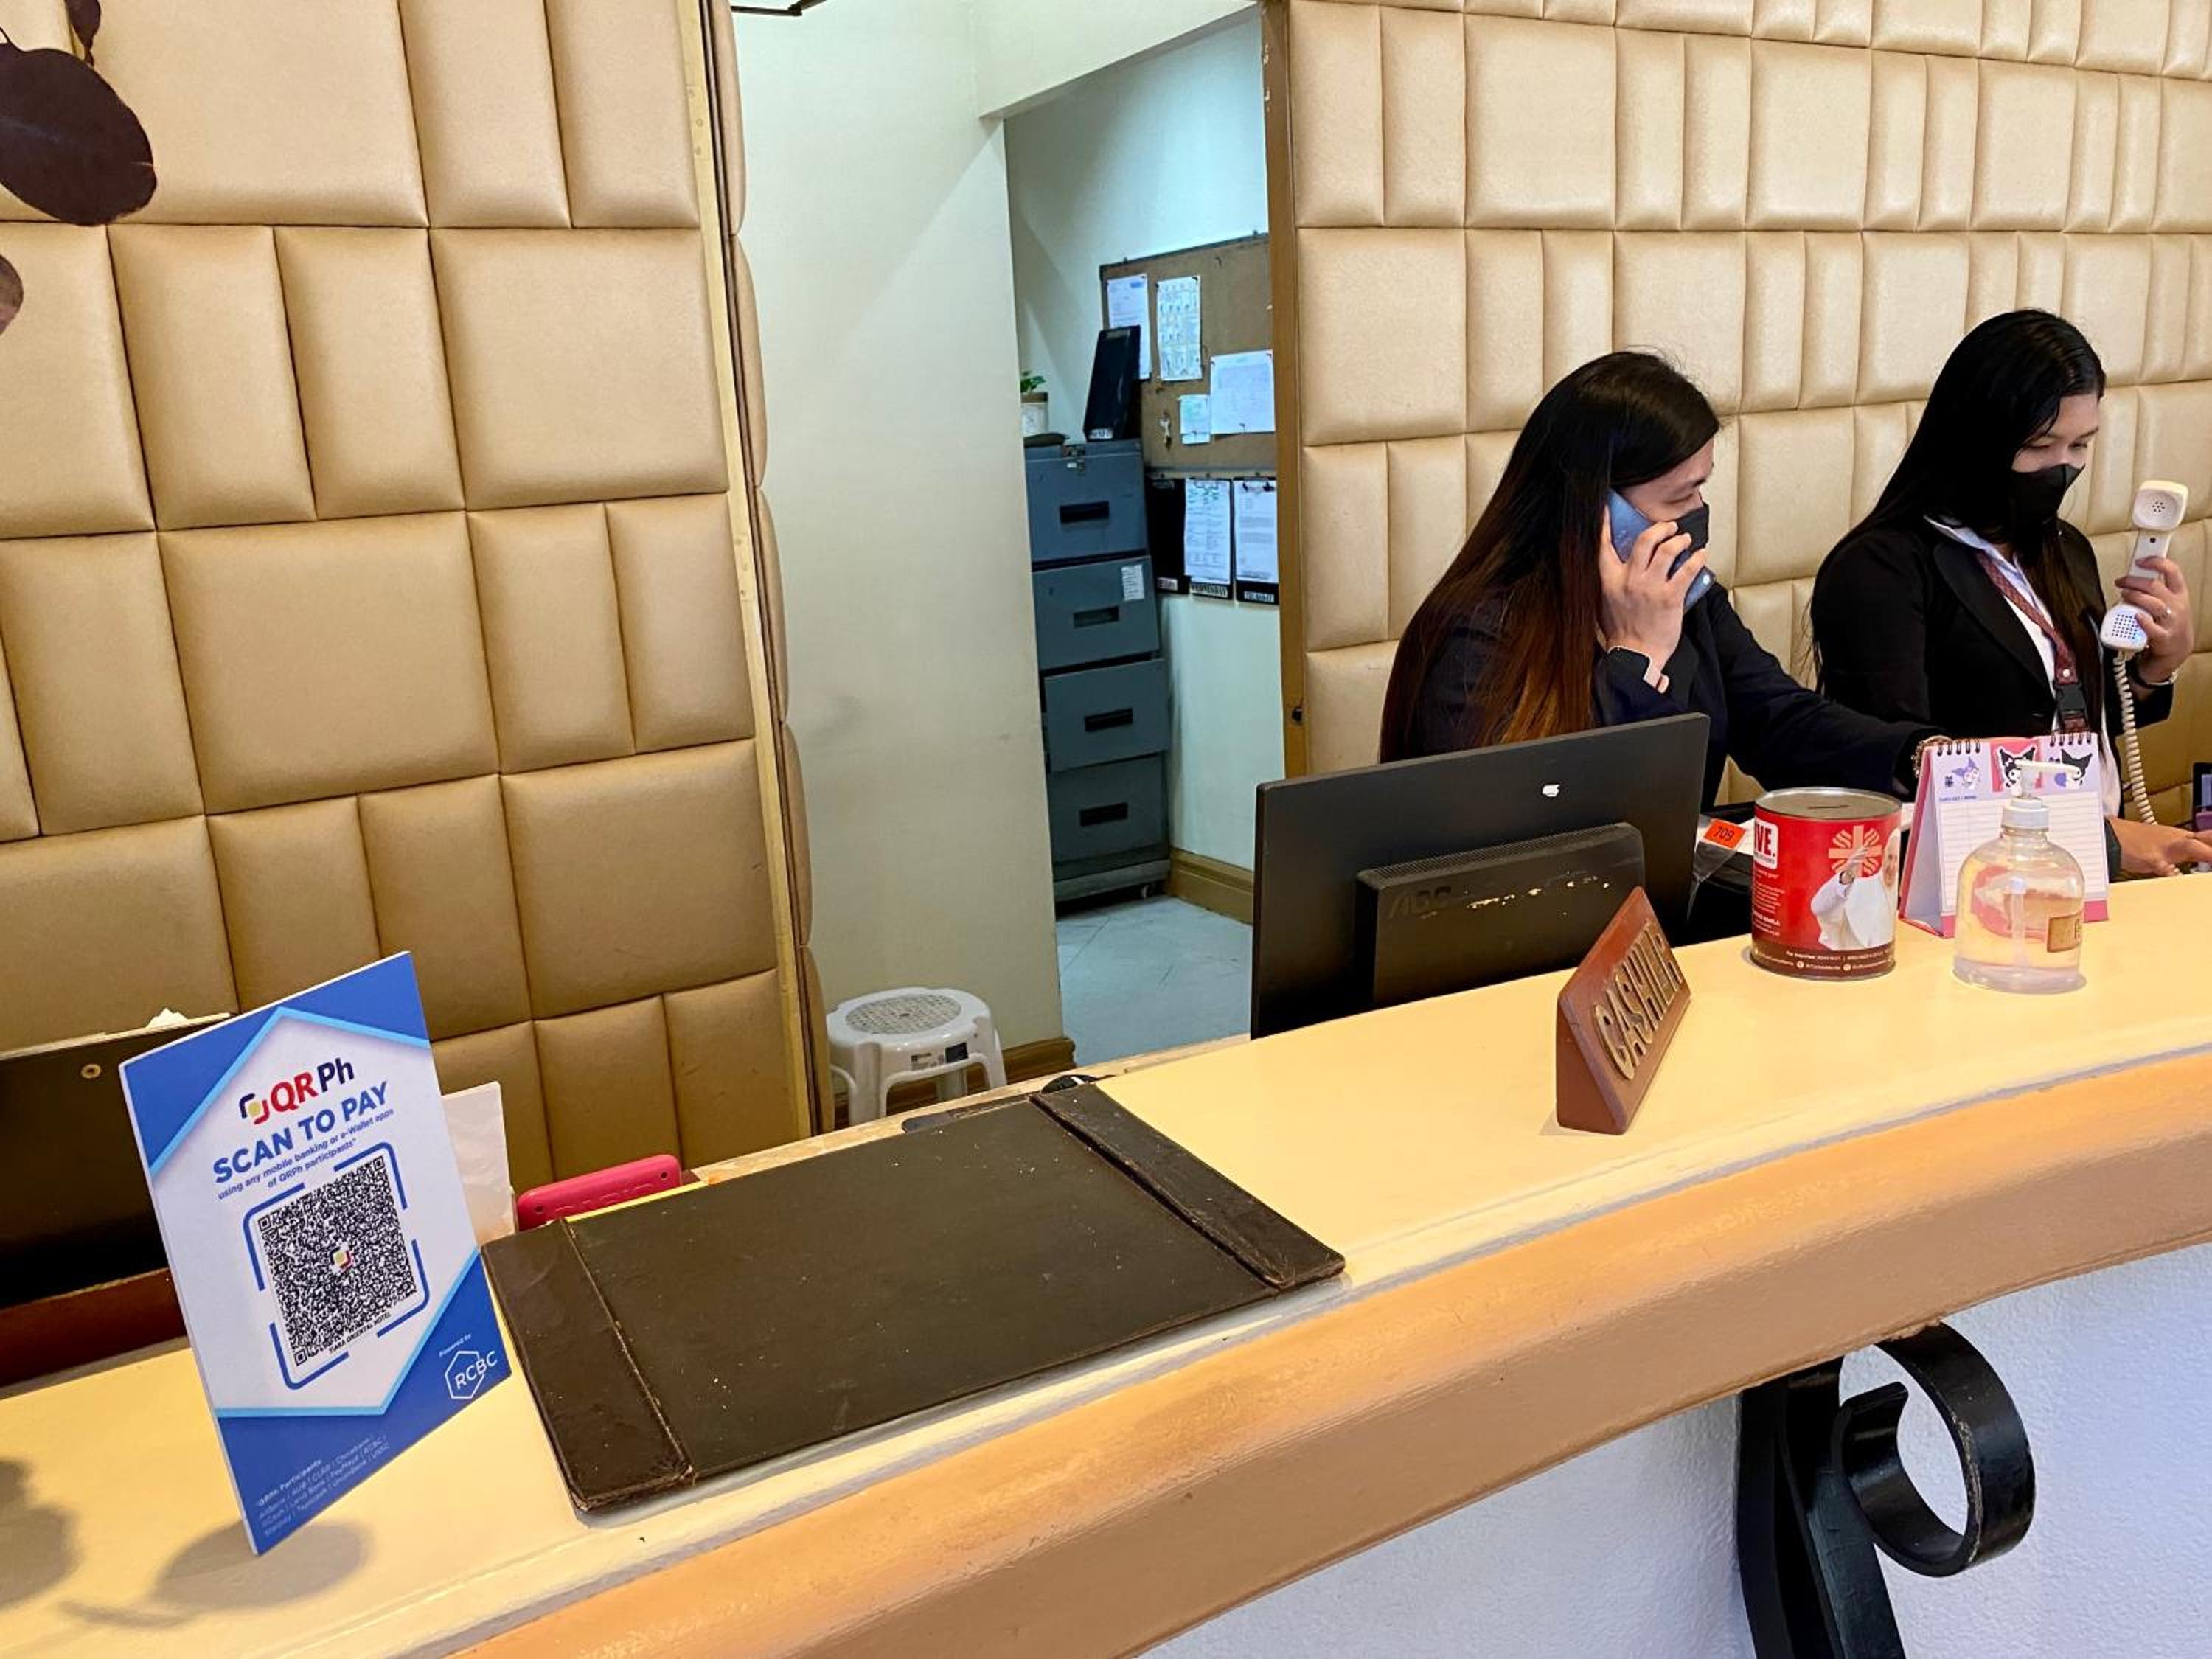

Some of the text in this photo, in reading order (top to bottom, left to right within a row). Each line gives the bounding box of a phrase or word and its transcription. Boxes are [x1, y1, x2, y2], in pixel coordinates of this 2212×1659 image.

[1713, 826, 1735, 841] 709
[1593, 919, 1683, 1081] CASHIER
[213, 1080, 387, 1183] SCAN TO PAY
[218, 1107, 394, 1200] using any mobile banking or e-Wallet apps
[268, 1177, 277, 1189] of
[279, 1164, 303, 1183] QRPh
[454, 1350, 498, 1390] RCBC
